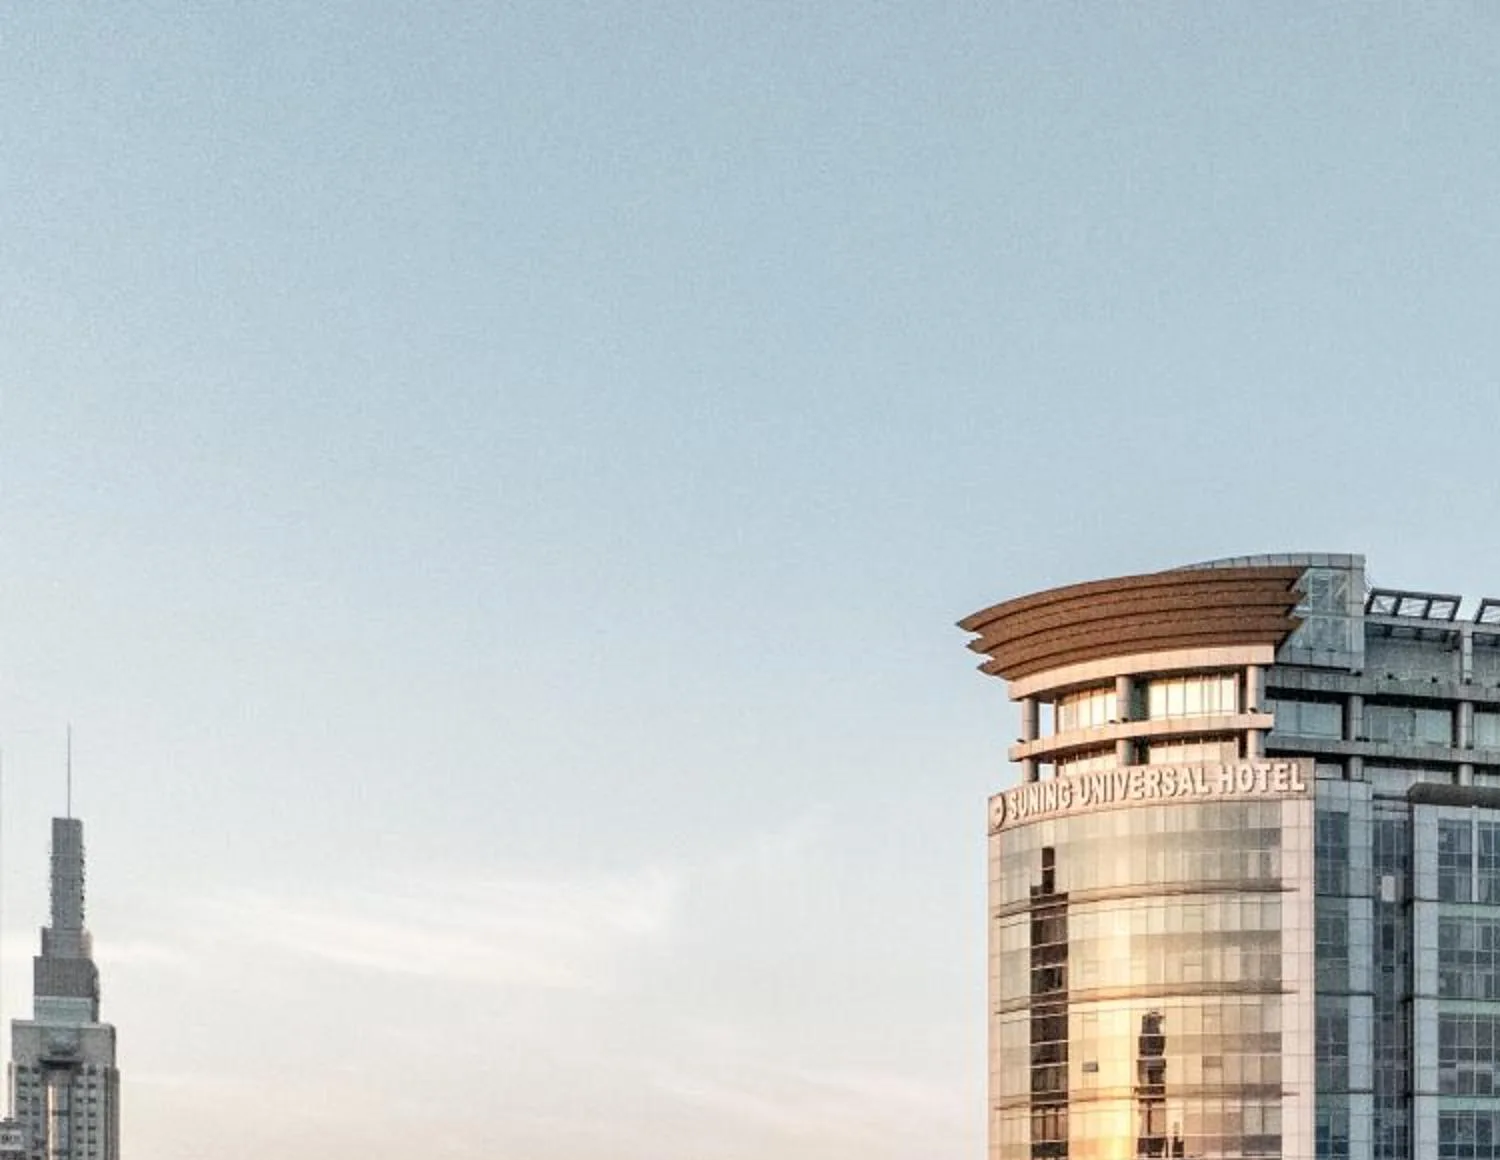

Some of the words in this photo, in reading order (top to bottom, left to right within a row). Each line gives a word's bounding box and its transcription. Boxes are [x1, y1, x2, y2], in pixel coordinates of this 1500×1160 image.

[1008, 778, 1072, 818] SUNING
[1078, 764, 1210, 807] UNIVERSAL
[1218, 763, 1306, 793] HOTEL
